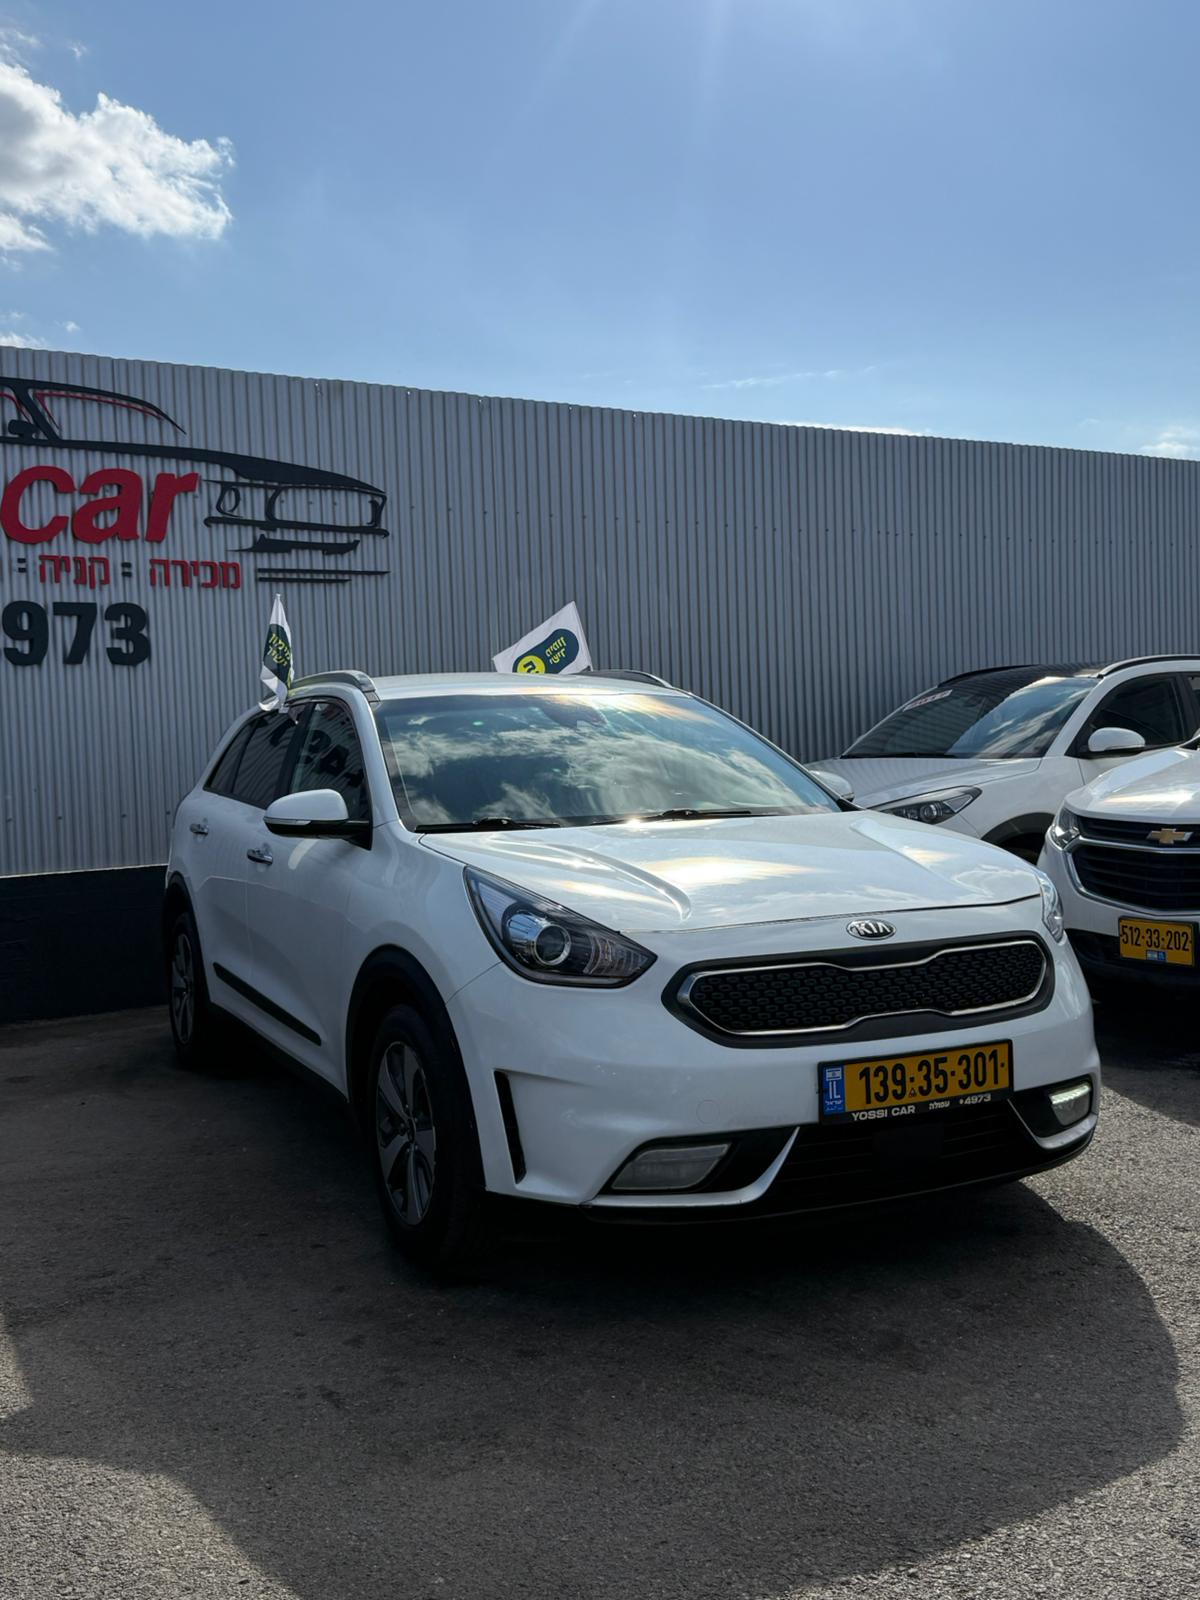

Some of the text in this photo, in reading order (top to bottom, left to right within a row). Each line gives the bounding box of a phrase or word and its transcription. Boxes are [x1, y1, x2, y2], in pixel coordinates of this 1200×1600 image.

[1, 465, 199, 544] car
[39, 554, 241, 591] מכירה קניה
[2, 601, 151, 666] 973
[853, 921, 892, 936] KIA
[829, 1080, 841, 1100] IL
[851, 1109, 889, 1121] YOSSI
[891, 1105, 916, 1116] CAR
